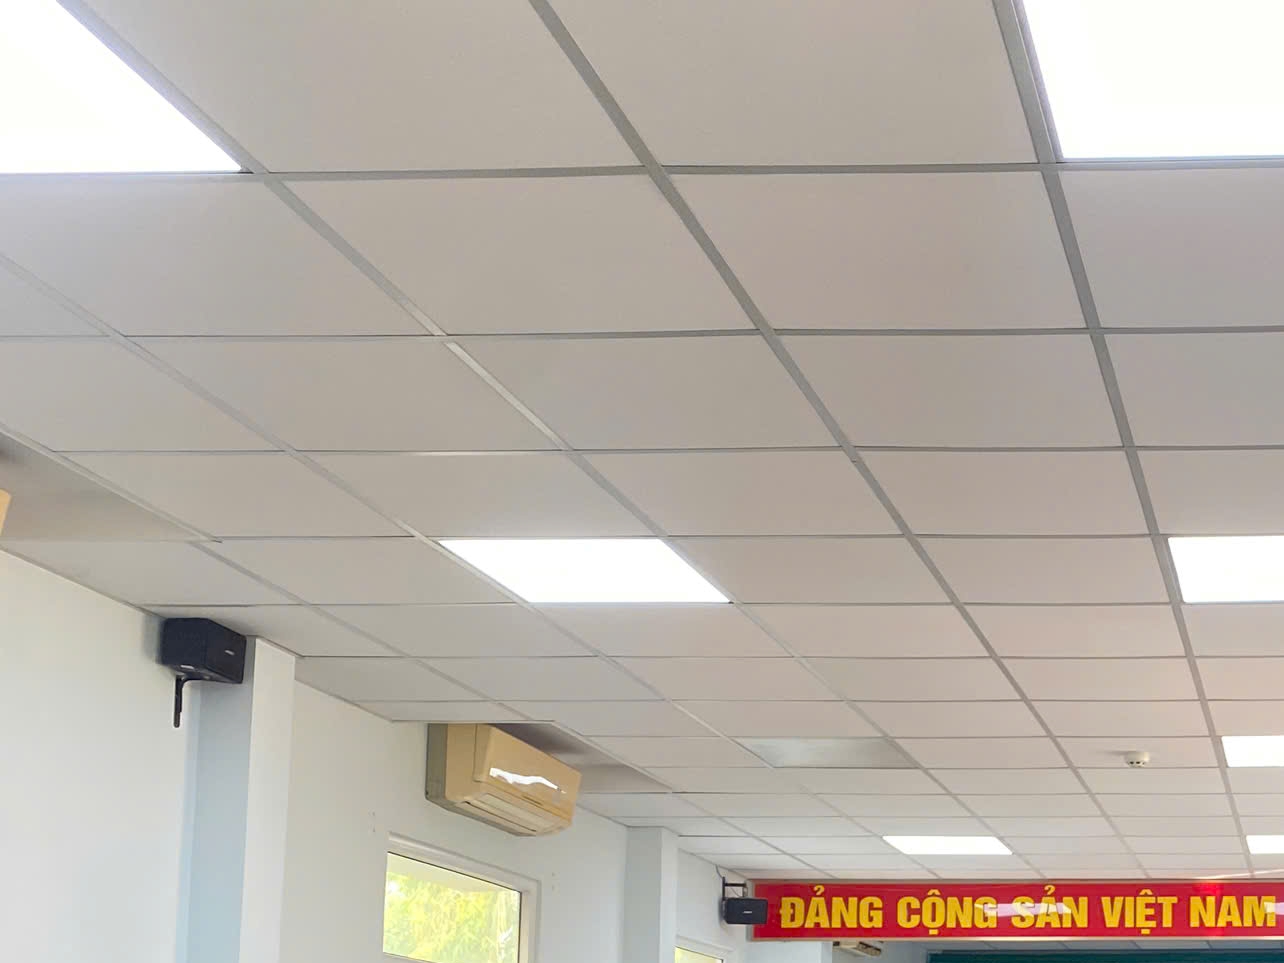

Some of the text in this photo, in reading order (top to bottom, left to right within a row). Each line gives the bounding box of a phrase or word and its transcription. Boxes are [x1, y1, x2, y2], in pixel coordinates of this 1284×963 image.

[780, 885, 883, 928] ĐẢNG
[897, 889, 998, 935] CỘNG
[1011, 885, 1088, 928] SẢN
[1101, 889, 1177, 934] VIỆT
[1190, 896, 1276, 928] NAM
